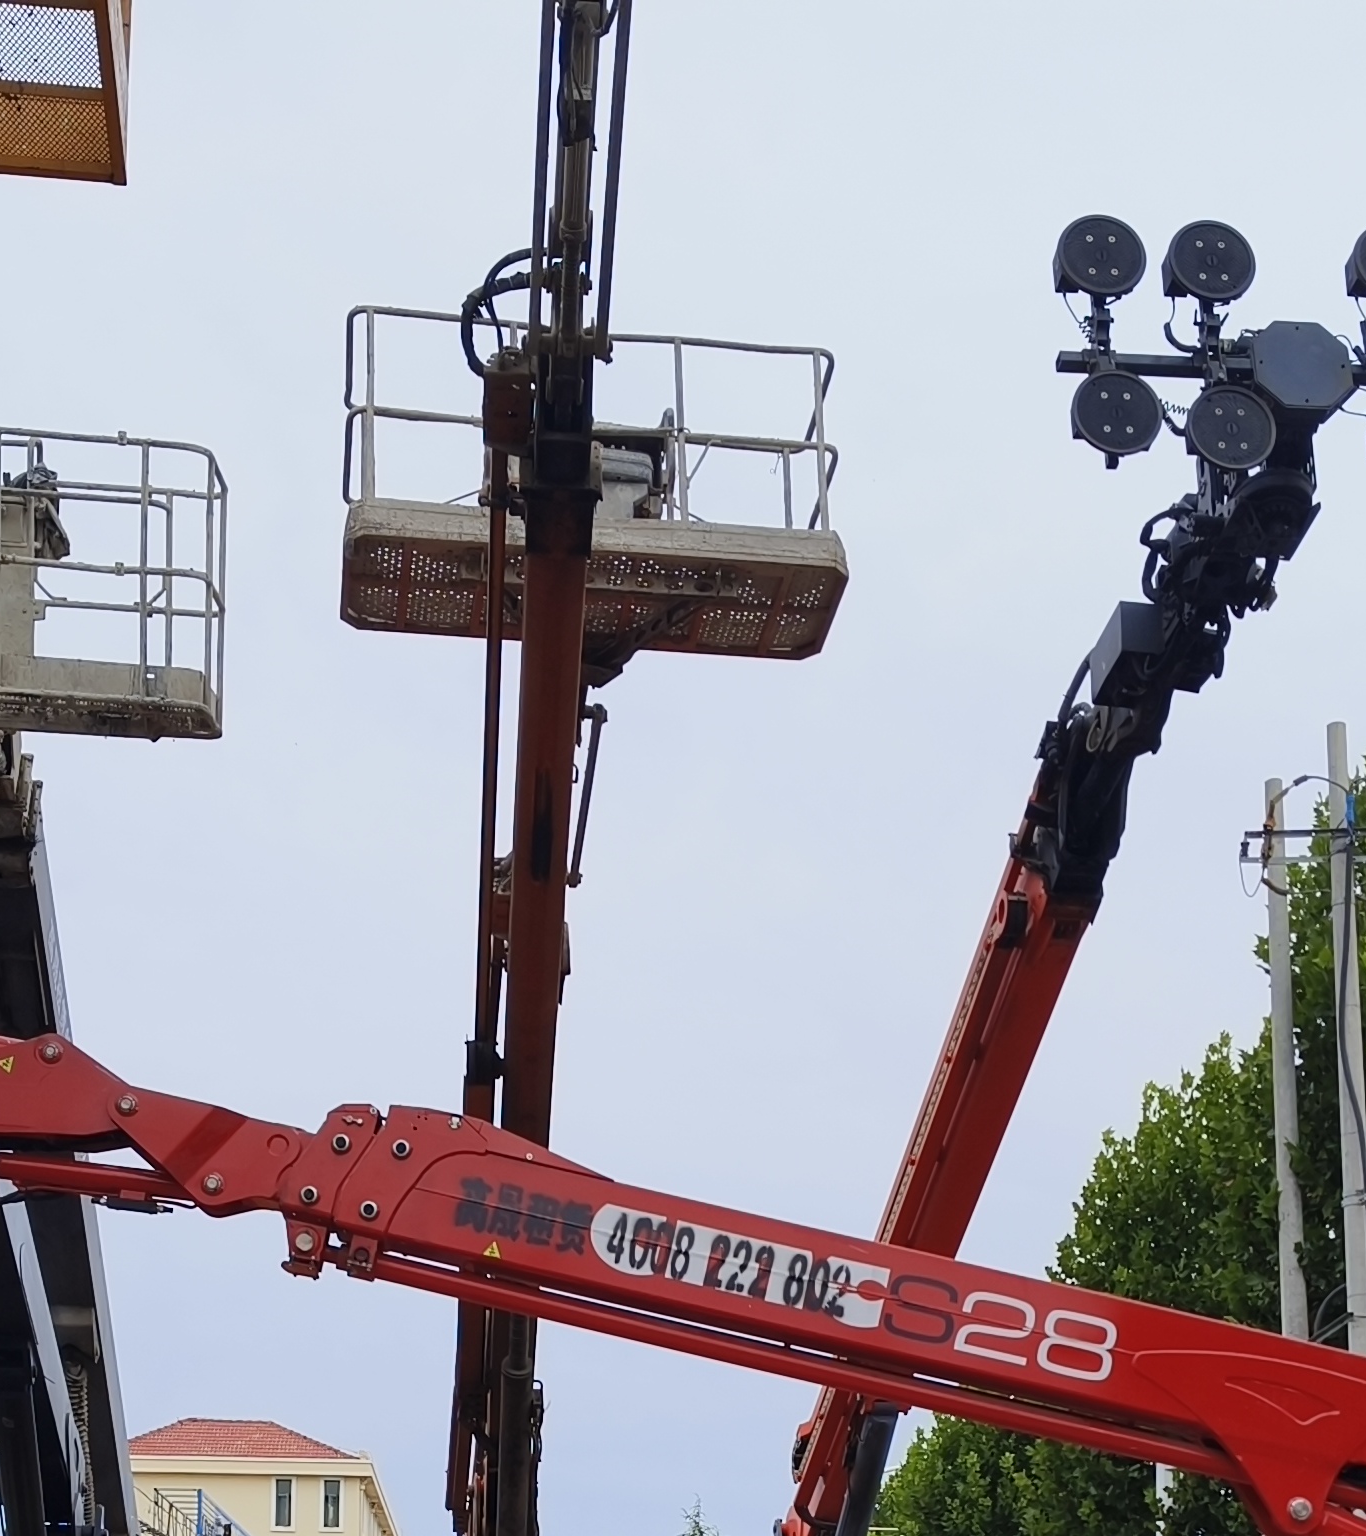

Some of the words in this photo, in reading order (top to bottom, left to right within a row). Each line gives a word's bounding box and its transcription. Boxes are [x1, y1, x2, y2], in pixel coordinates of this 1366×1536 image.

[607, 1213, 695, 1280] 4008
[704, 1235, 775, 1298] 222
[783, 1253, 852, 1318] 802
